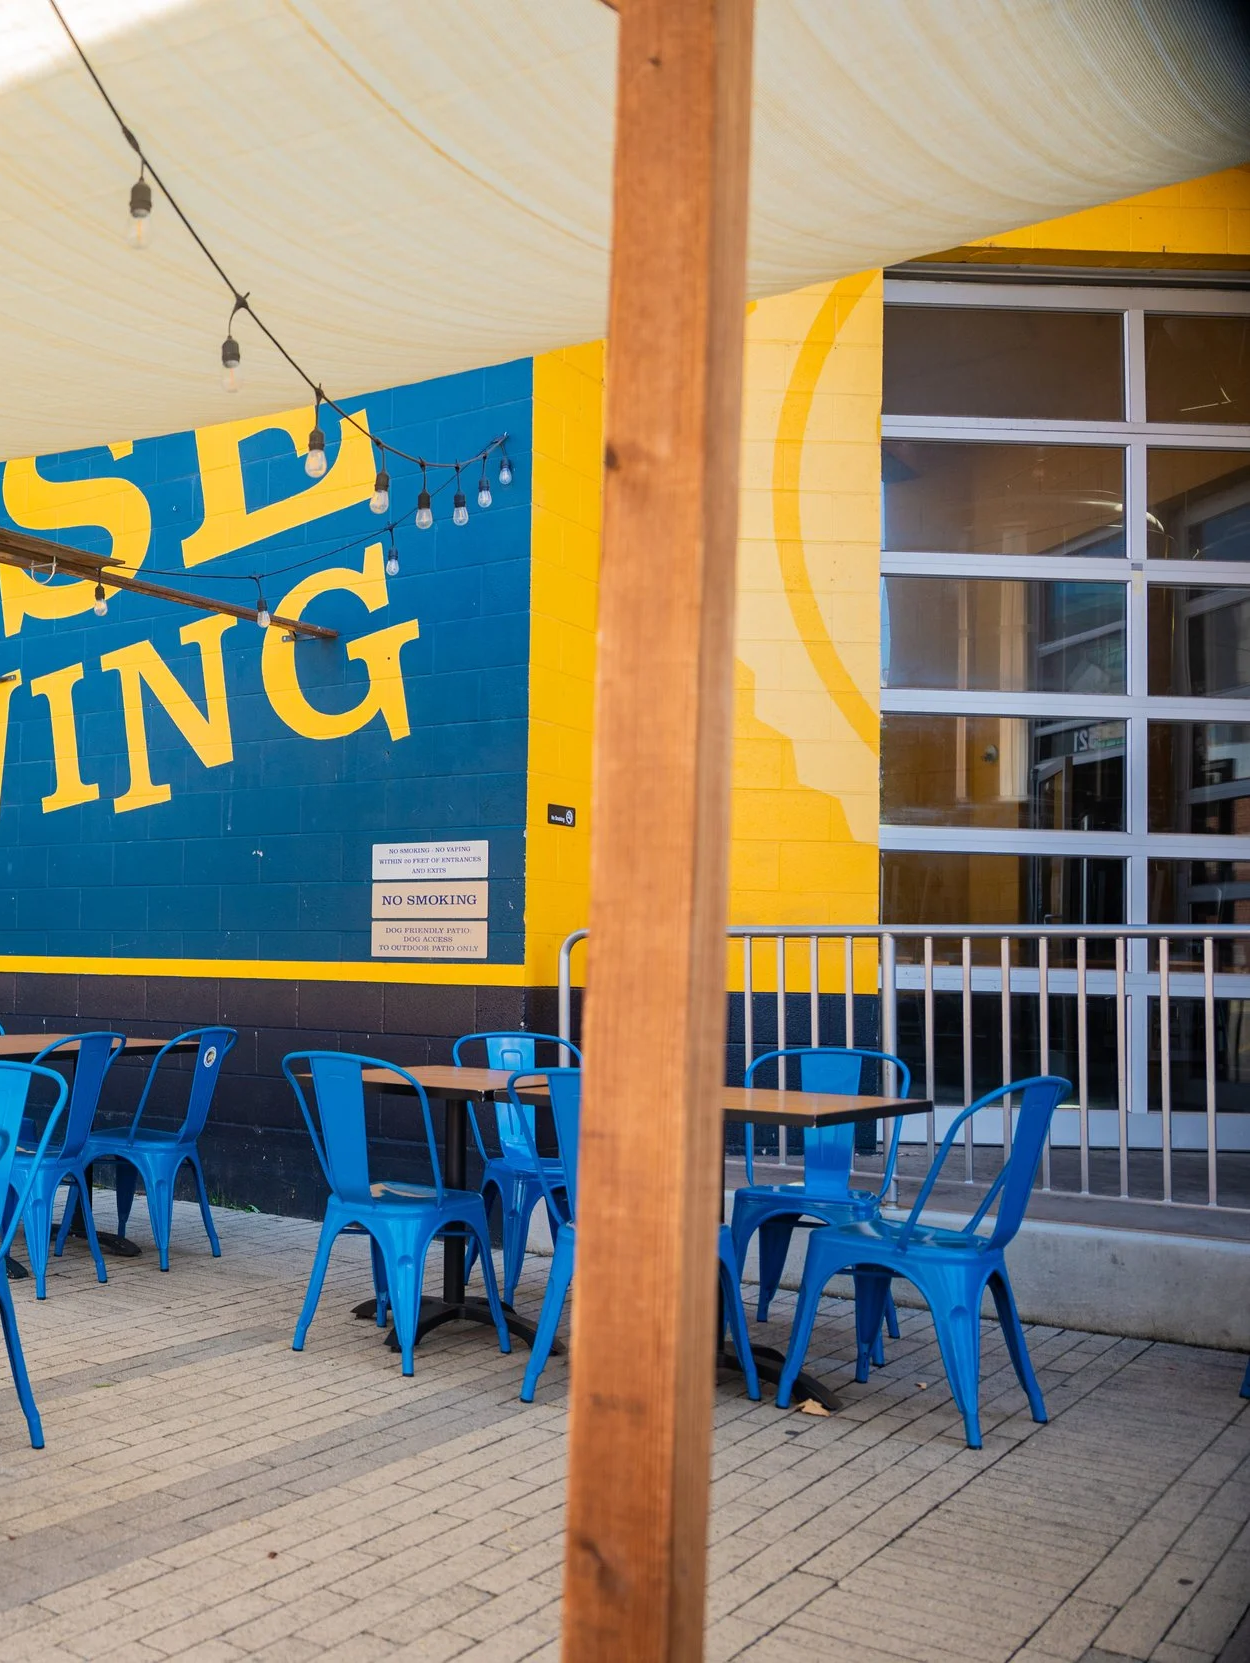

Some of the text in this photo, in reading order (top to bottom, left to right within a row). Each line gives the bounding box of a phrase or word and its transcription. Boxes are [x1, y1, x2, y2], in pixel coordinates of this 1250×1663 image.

[381, 894, 478, 906] NO SMOKING
[390, 944, 430, 952] OUTDOOR
